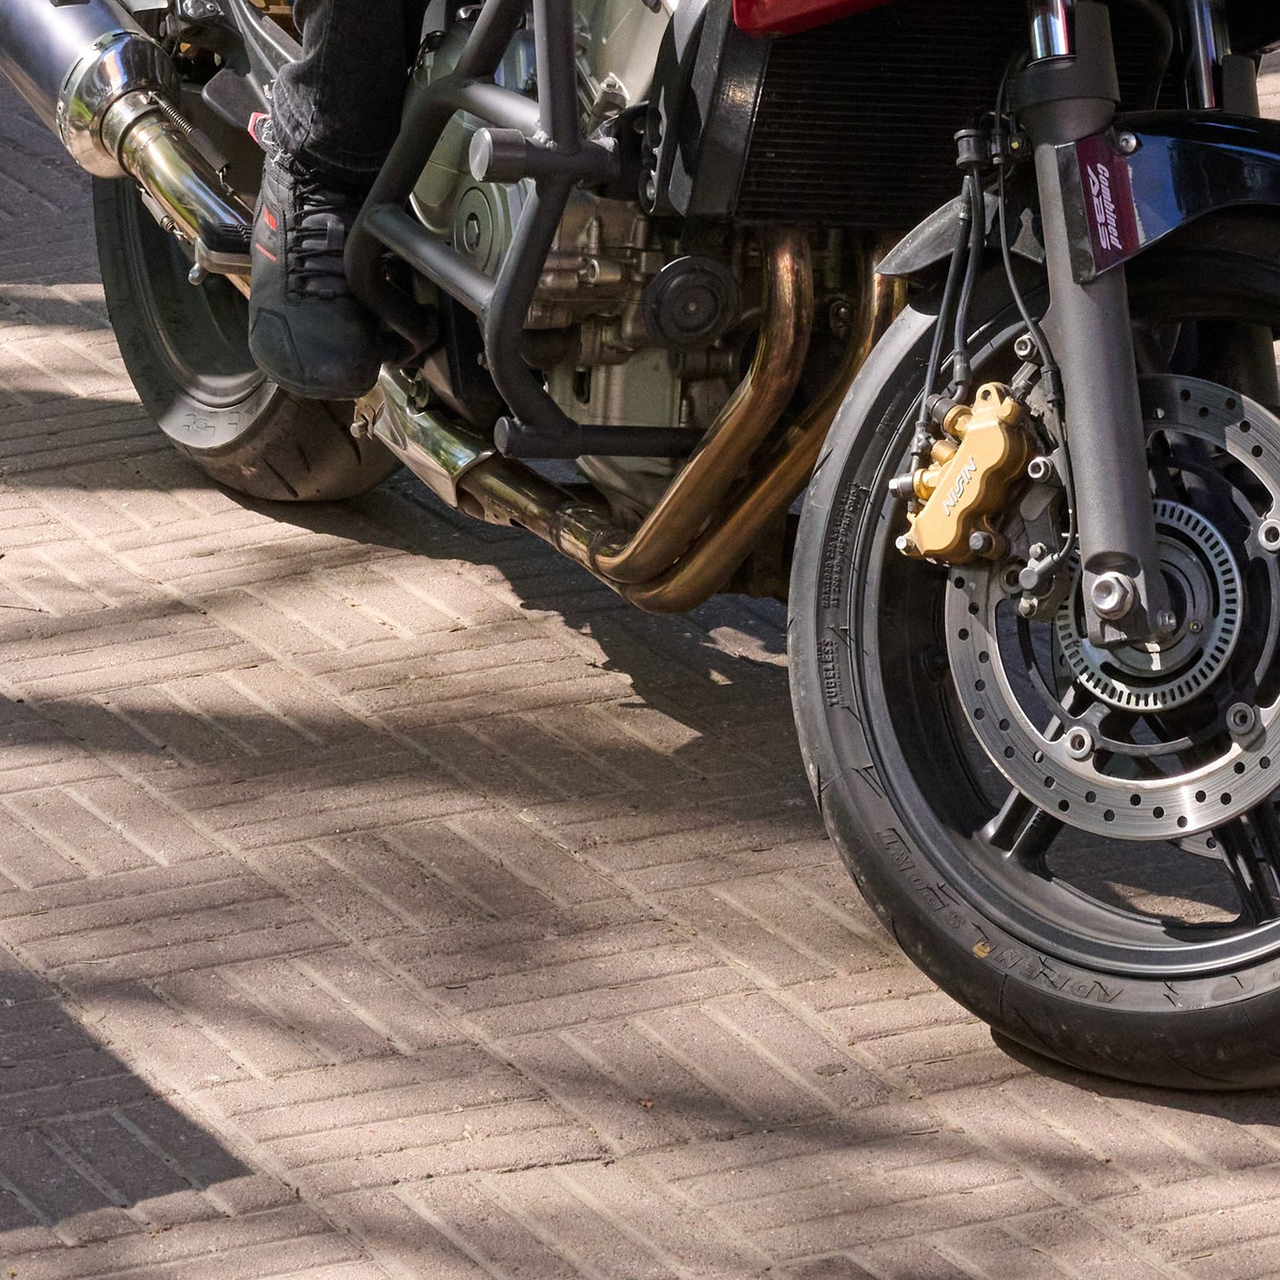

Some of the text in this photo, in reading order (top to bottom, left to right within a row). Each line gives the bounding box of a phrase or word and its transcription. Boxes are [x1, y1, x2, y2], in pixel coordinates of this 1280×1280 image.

[1087, 164, 1111, 250] ABS
[1097, 163, 1123, 250] Combined
[821, 638, 840, 708] TUBELESS
